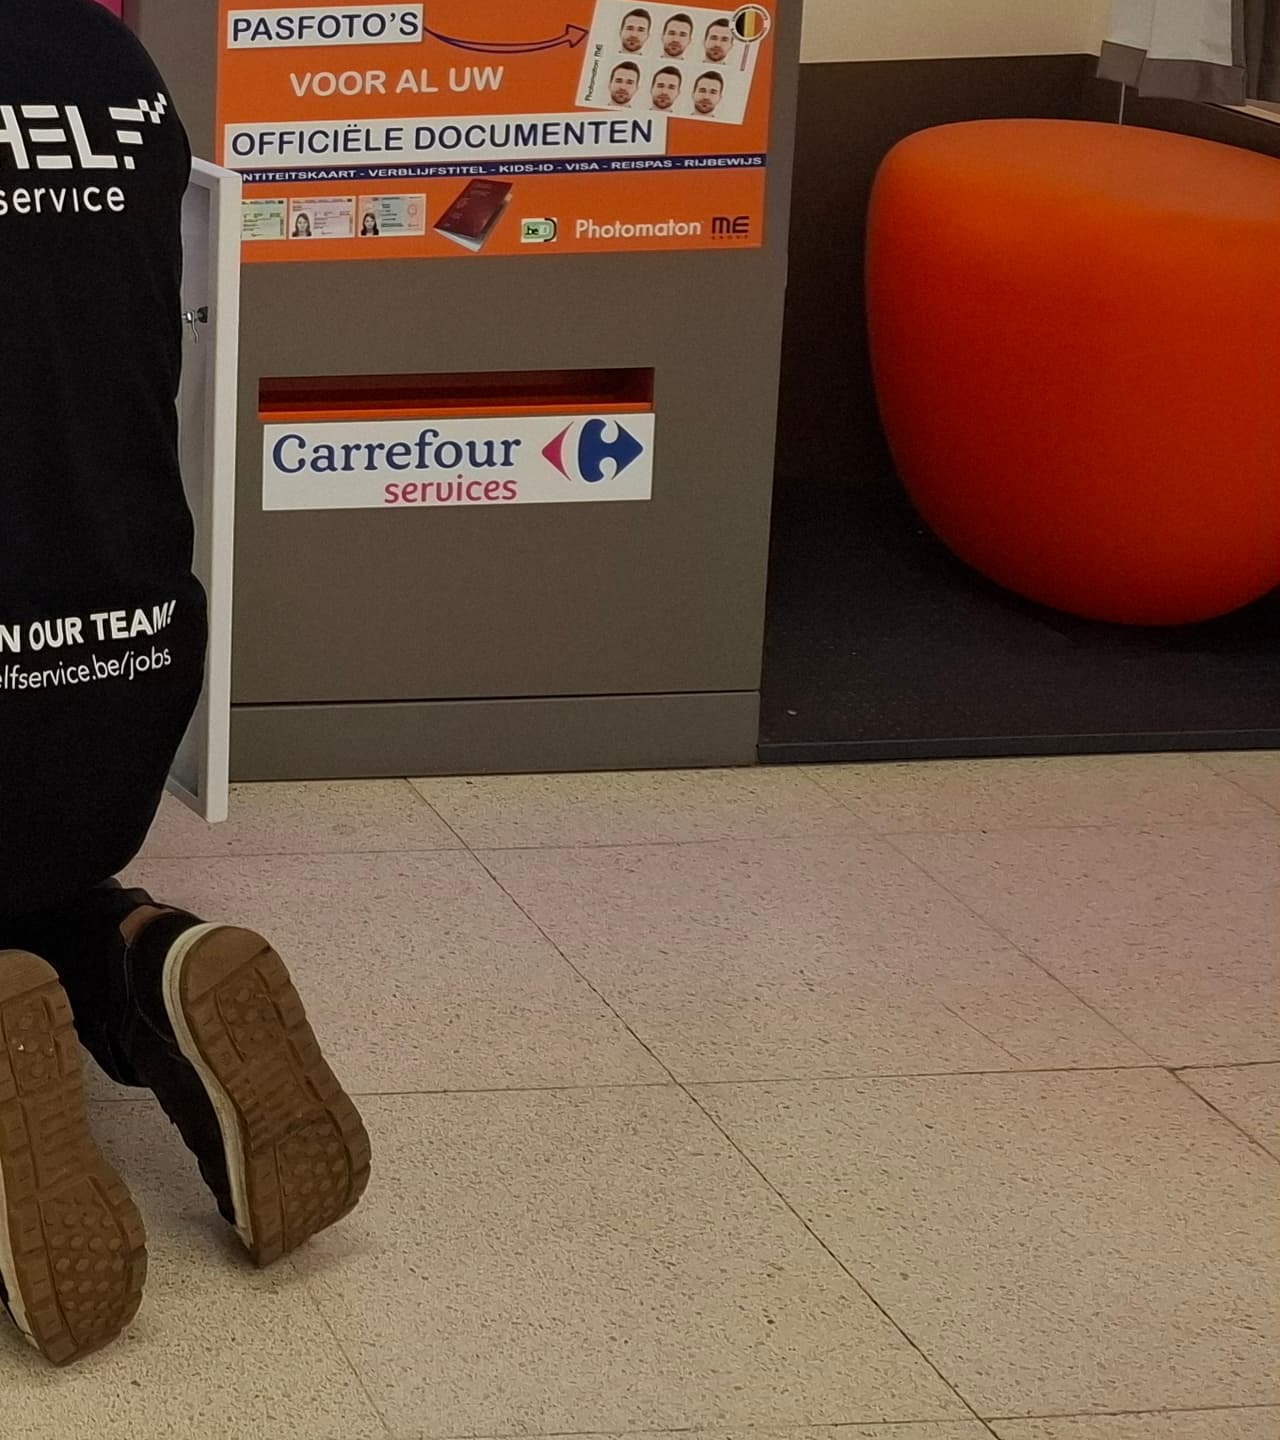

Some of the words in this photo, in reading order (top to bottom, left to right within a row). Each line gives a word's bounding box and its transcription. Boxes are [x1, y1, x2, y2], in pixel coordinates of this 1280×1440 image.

[232, 11, 419, 43] PASFOTO'S
[289, 70, 386, 98] VOOR
[396, 69, 439, 94] AL
[448, 66, 504, 92] UW
[231, 124, 404, 157] OFFICIËLE
[414, 118, 653, 152] DOCUMENTEN
[242, 168, 356, 183] NTITEITSKAART
[369, 165, 484, 179] VERBLIJFSTITEL
[499, 162, 554, 174] KIDS-ID
[566, 161, 599, 172] VISA
[611, 158, 673, 171] REISPAS
[685, 156, 762, 169] RIJBEWIJS
[575, 218, 701, 239] Photomaton
[272, 428, 522, 474] Carrefour
[384, 474, 517, 503] services
[28, 615, 84, 651] OUR
[90, 600, 176, 640] TEAM!
